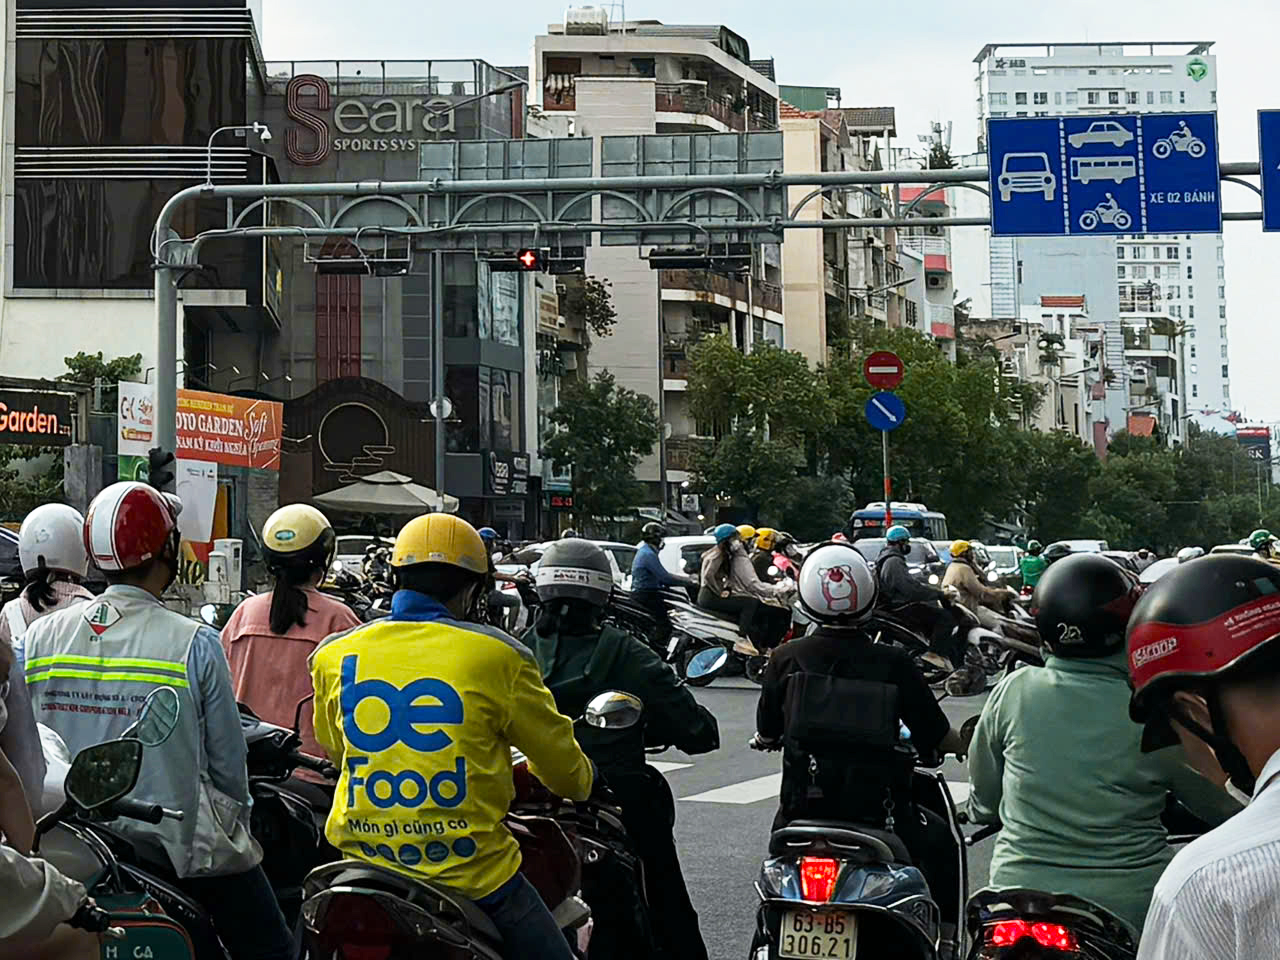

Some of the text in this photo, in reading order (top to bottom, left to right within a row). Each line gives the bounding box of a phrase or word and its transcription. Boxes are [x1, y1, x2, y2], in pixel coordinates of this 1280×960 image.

[286, 74, 456, 167] Seara
[1149, 188, 1215, 204] XE 02 BÁNH
[176, 411, 196, 431] OYO
[198, 414, 244, 437] GARDEN
[340, 654, 465, 753] be
[346, 756, 468, 809] Food
[348, 818, 380, 833] Món
[784, 934, 851, 958] 306.21
